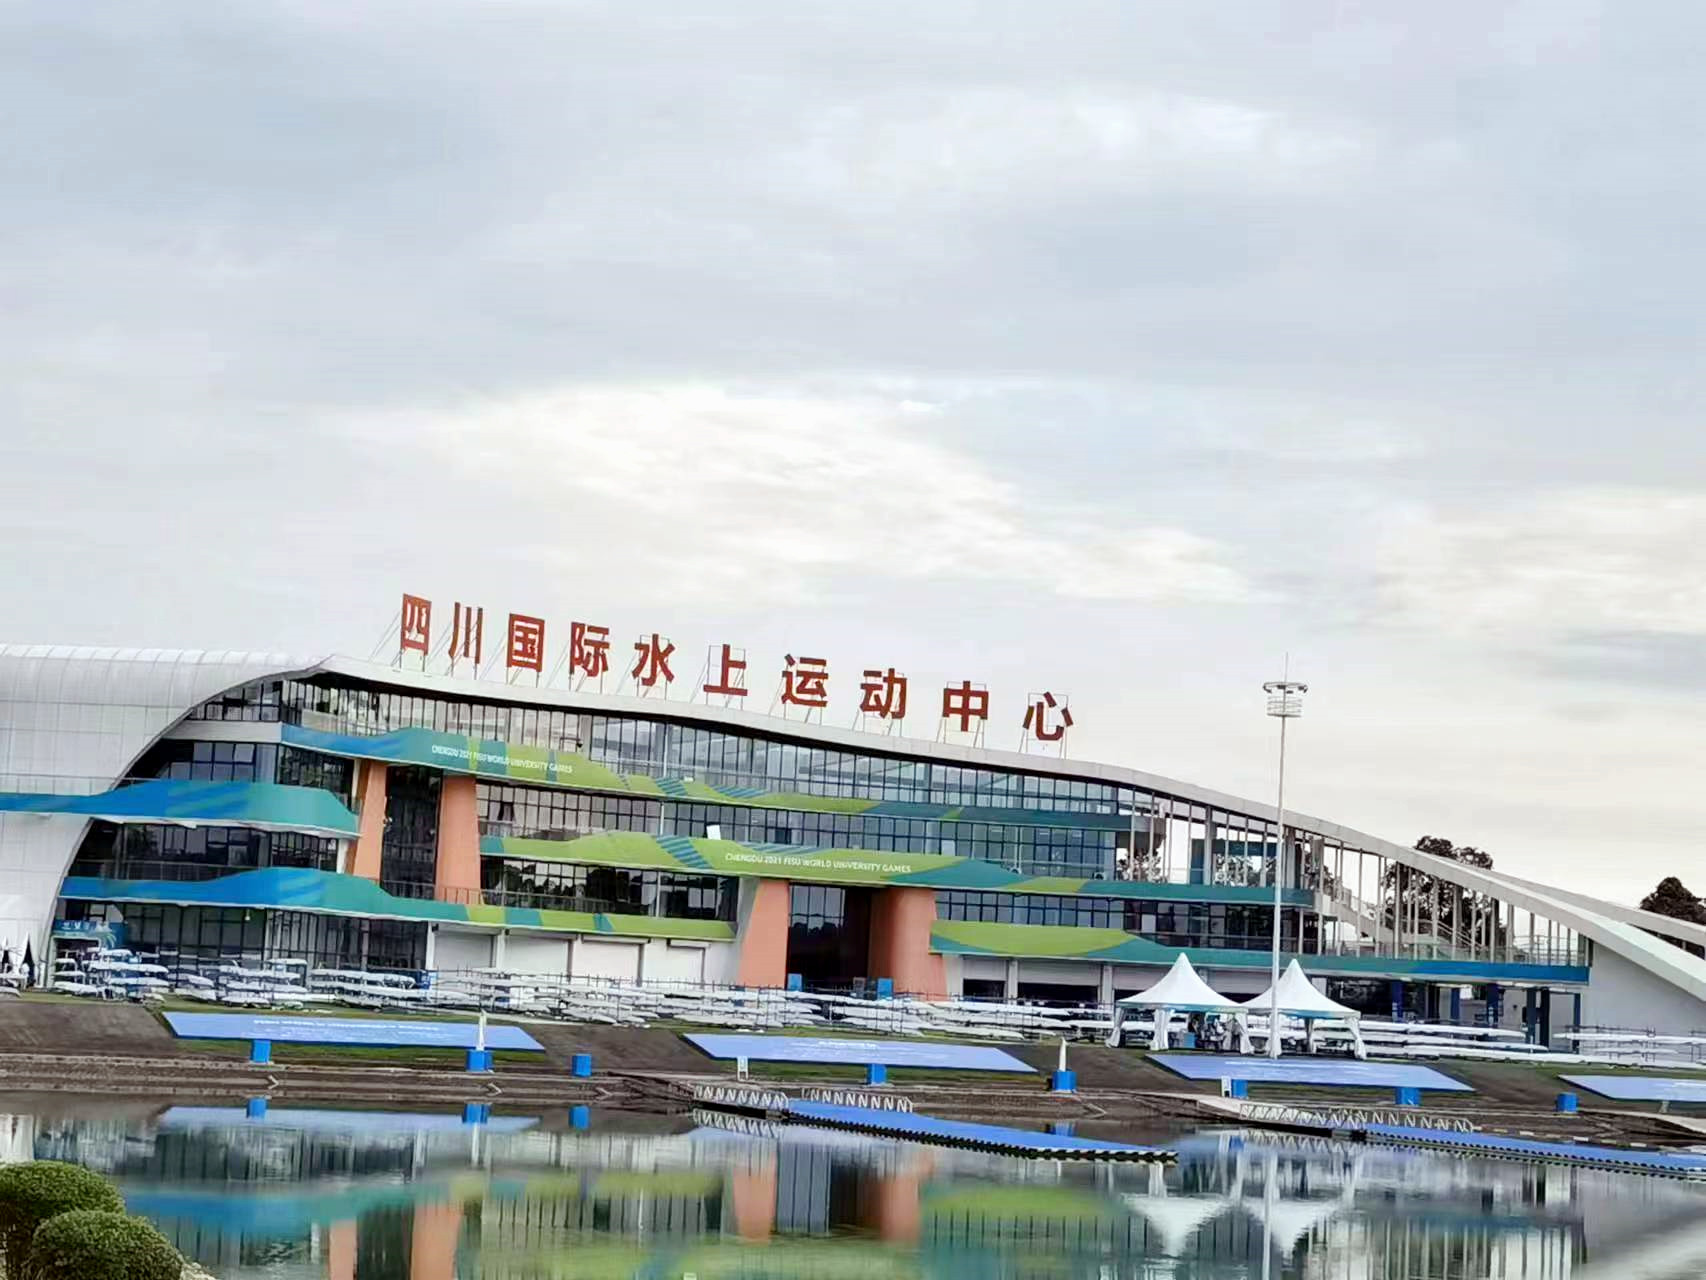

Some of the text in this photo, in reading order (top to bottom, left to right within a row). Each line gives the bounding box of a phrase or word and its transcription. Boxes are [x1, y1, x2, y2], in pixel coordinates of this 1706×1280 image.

[400, 593, 1073, 741] 四川国际水上运动中心
[803, 858, 831, 868] WORLD
[833, 860, 880, 871] UNIVERSITY
[882, 864, 911, 873] GAMES
